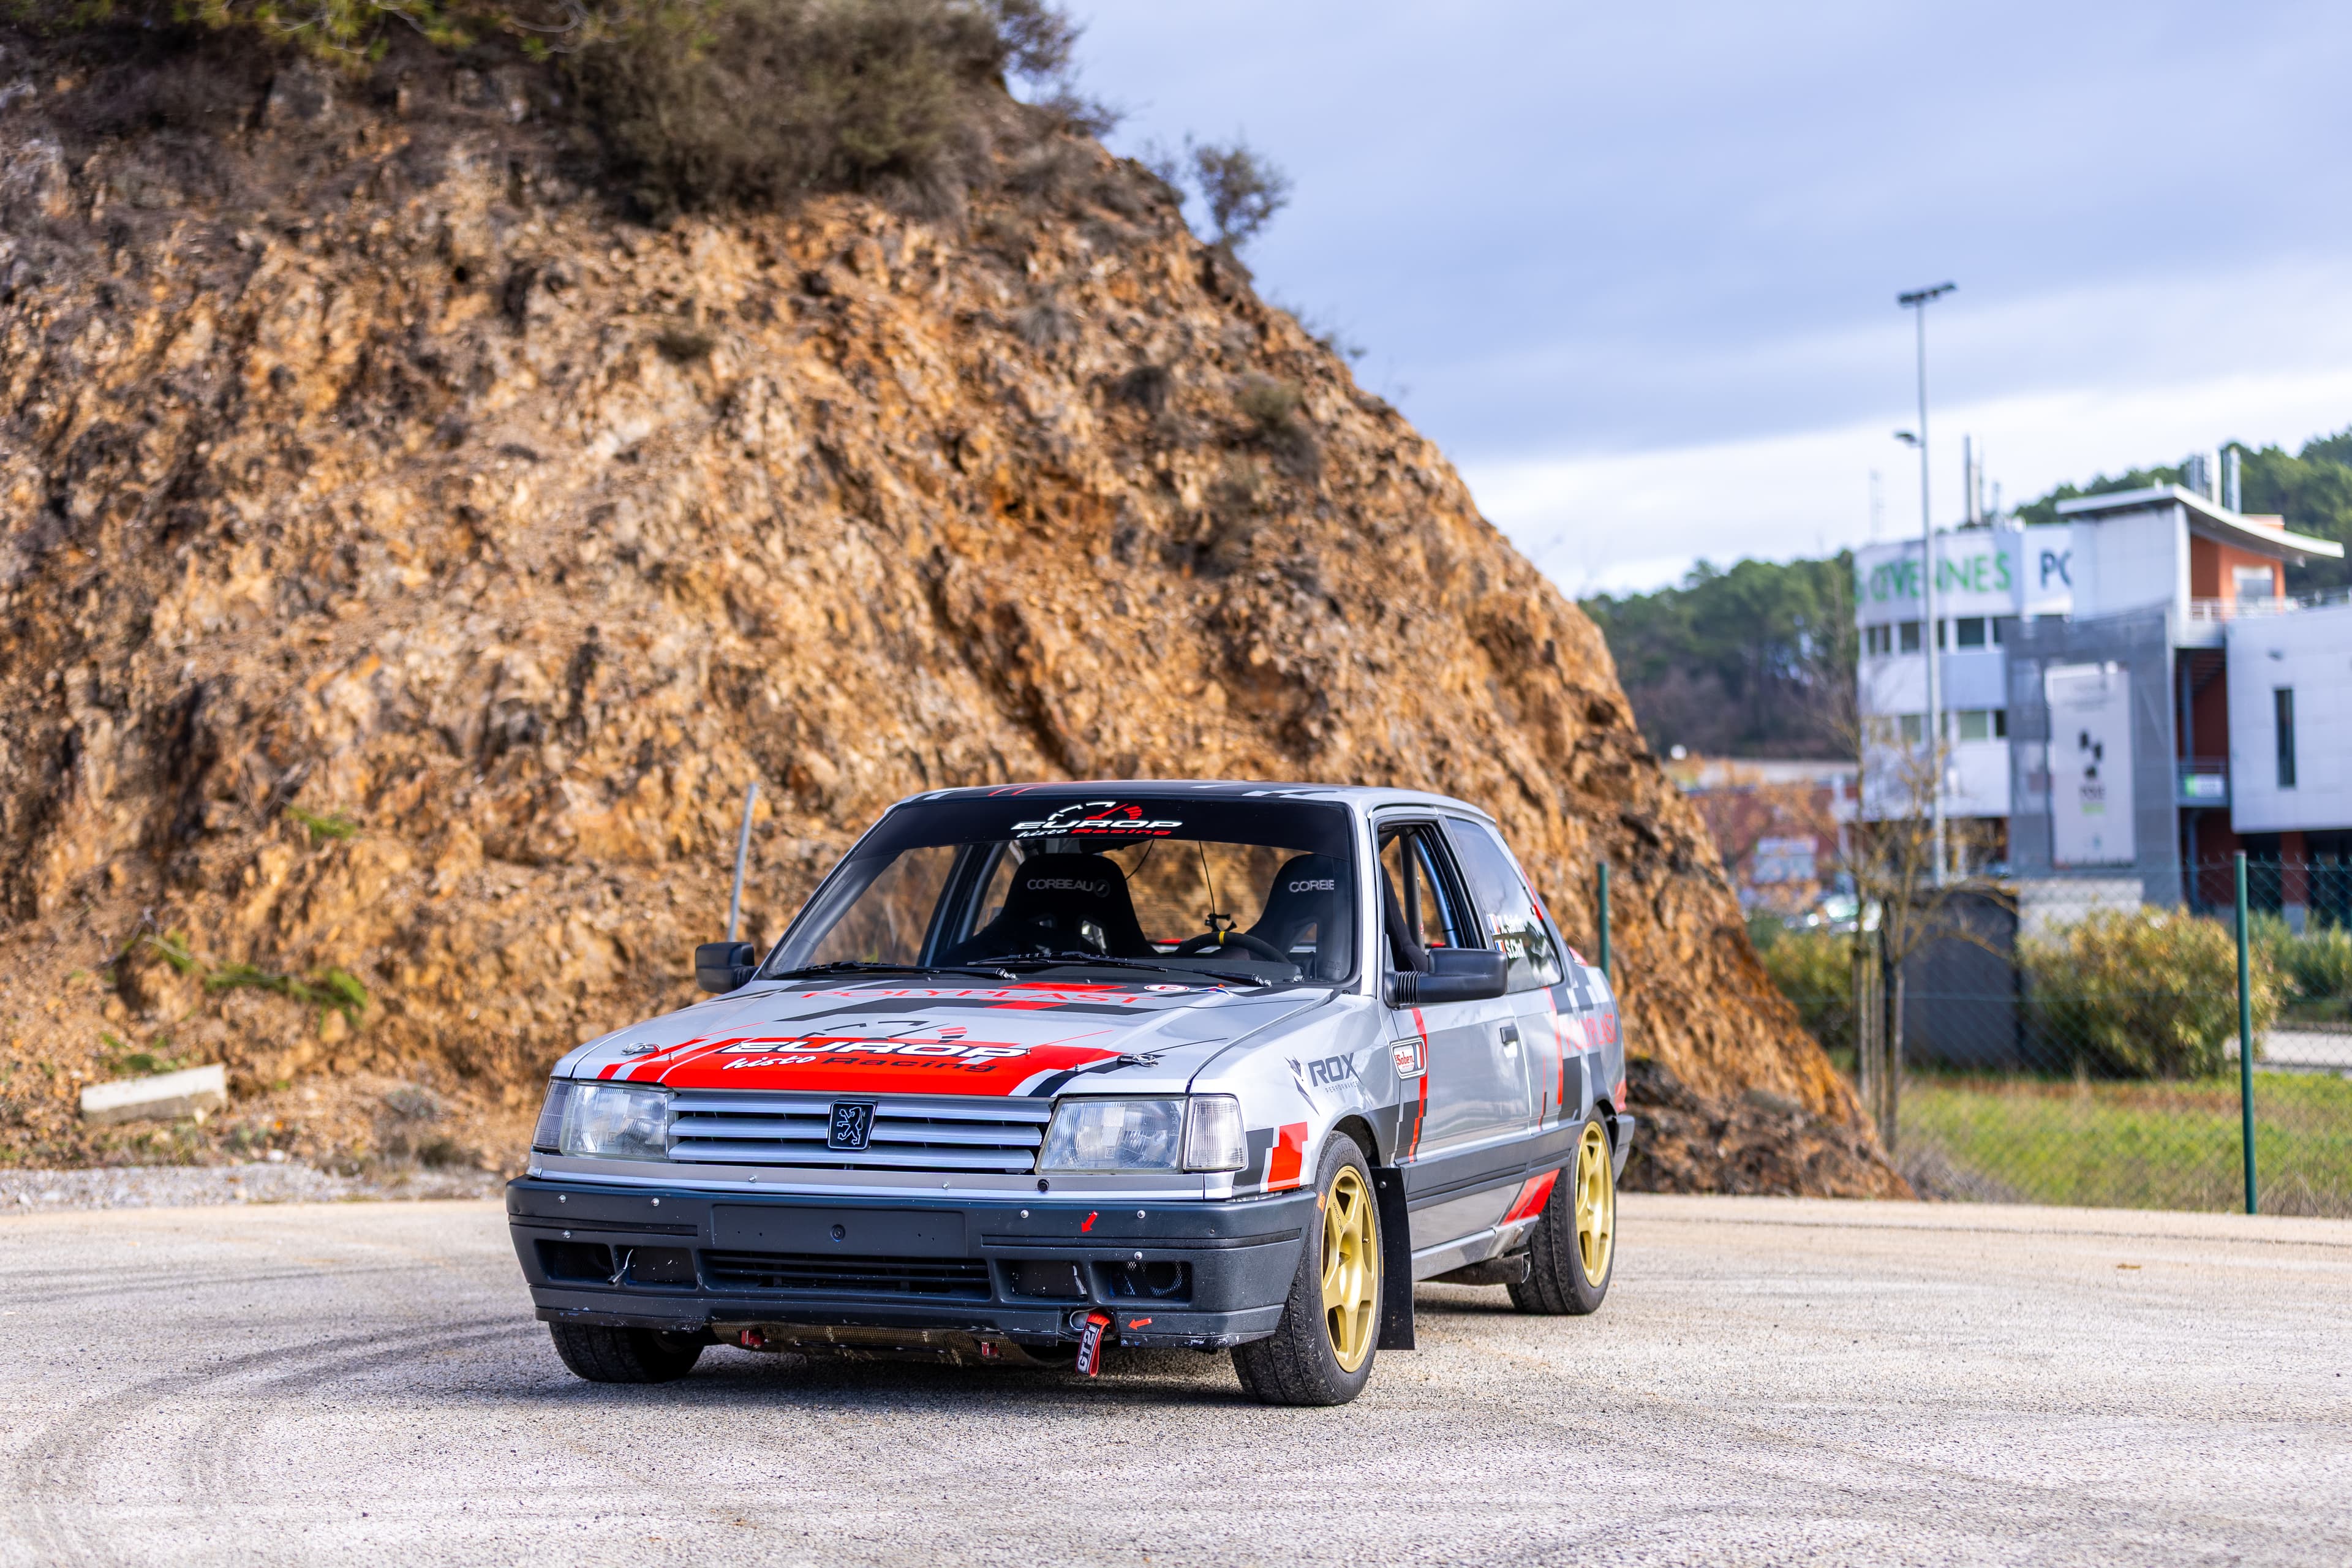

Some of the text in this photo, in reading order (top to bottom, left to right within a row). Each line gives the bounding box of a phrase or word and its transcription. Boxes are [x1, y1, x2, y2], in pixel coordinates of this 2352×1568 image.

[1011, 820, 1183, 830] EUROP
[1017, 829, 1068, 838] histo
[1027, 878, 1093, 892] CORBEAU
[800, 989, 1156, 1003] POLYPLAST
[717, 1039, 1030, 1058] EUROP
[722, 1055, 998, 1072] histo Racing
[1308, 1052, 1363, 1087] ROX
